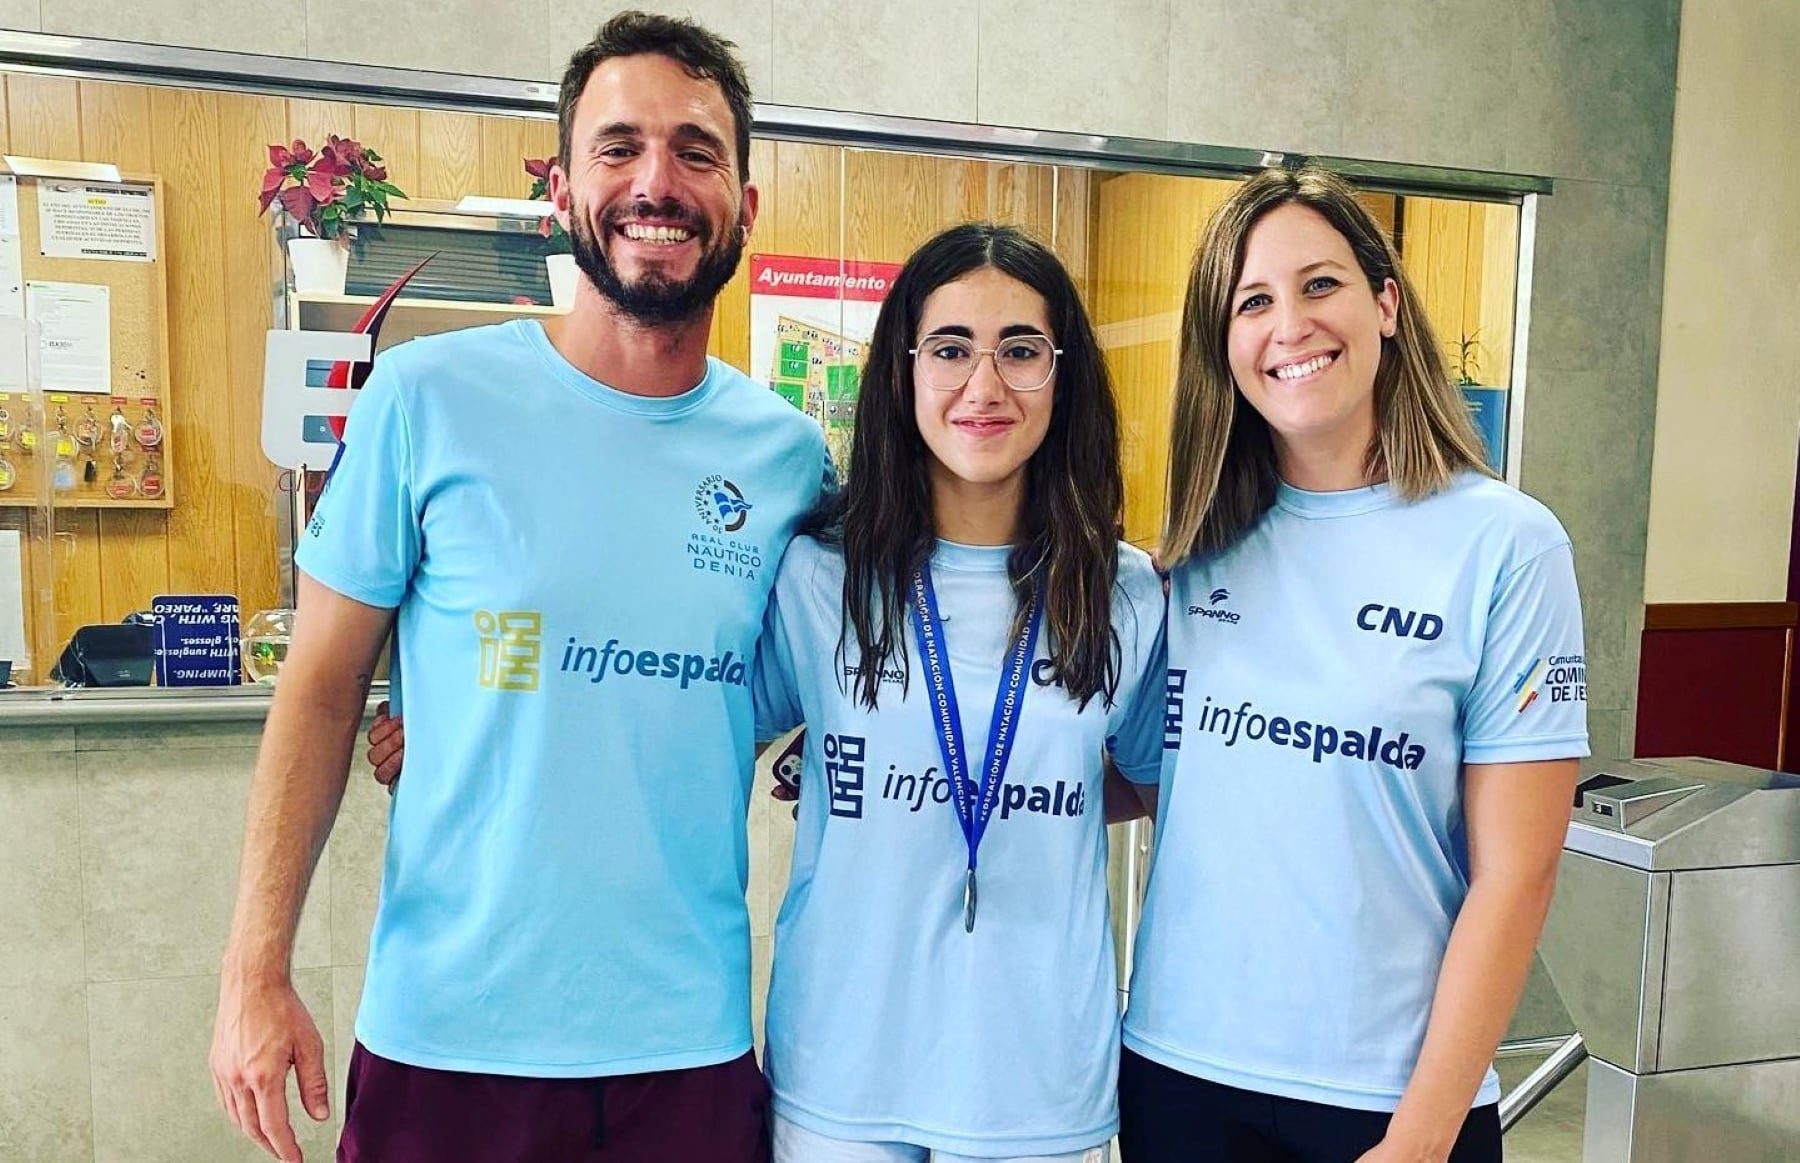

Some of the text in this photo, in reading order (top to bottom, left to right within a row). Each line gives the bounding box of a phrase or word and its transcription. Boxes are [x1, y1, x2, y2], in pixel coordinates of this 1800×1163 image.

[757, 267, 886, 290] Ayuntamiento
[691, 533, 759, 554] REAL CLUB
[693, 558, 755, 581] DENIA
[178, 614, 216, 624] WITH
[1187, 605, 1241, 621] SPANNO
[1356, 603, 1445, 641] CND
[923, 624, 933, 638] DE
[925, 638, 943, 692] NATACIÓN
[1010, 626, 1031, 688] COMUNIDAD
[1551, 686, 1571, 703] DE
[937, 692, 957, 756] COMUNIDAD
[999, 690, 1016, 742] NATACIÓN
[1198, 695, 1426, 771] infoespalda
[995, 742, 1005, 756] DE
[950, 757, 969, 820] VALENCIANA
